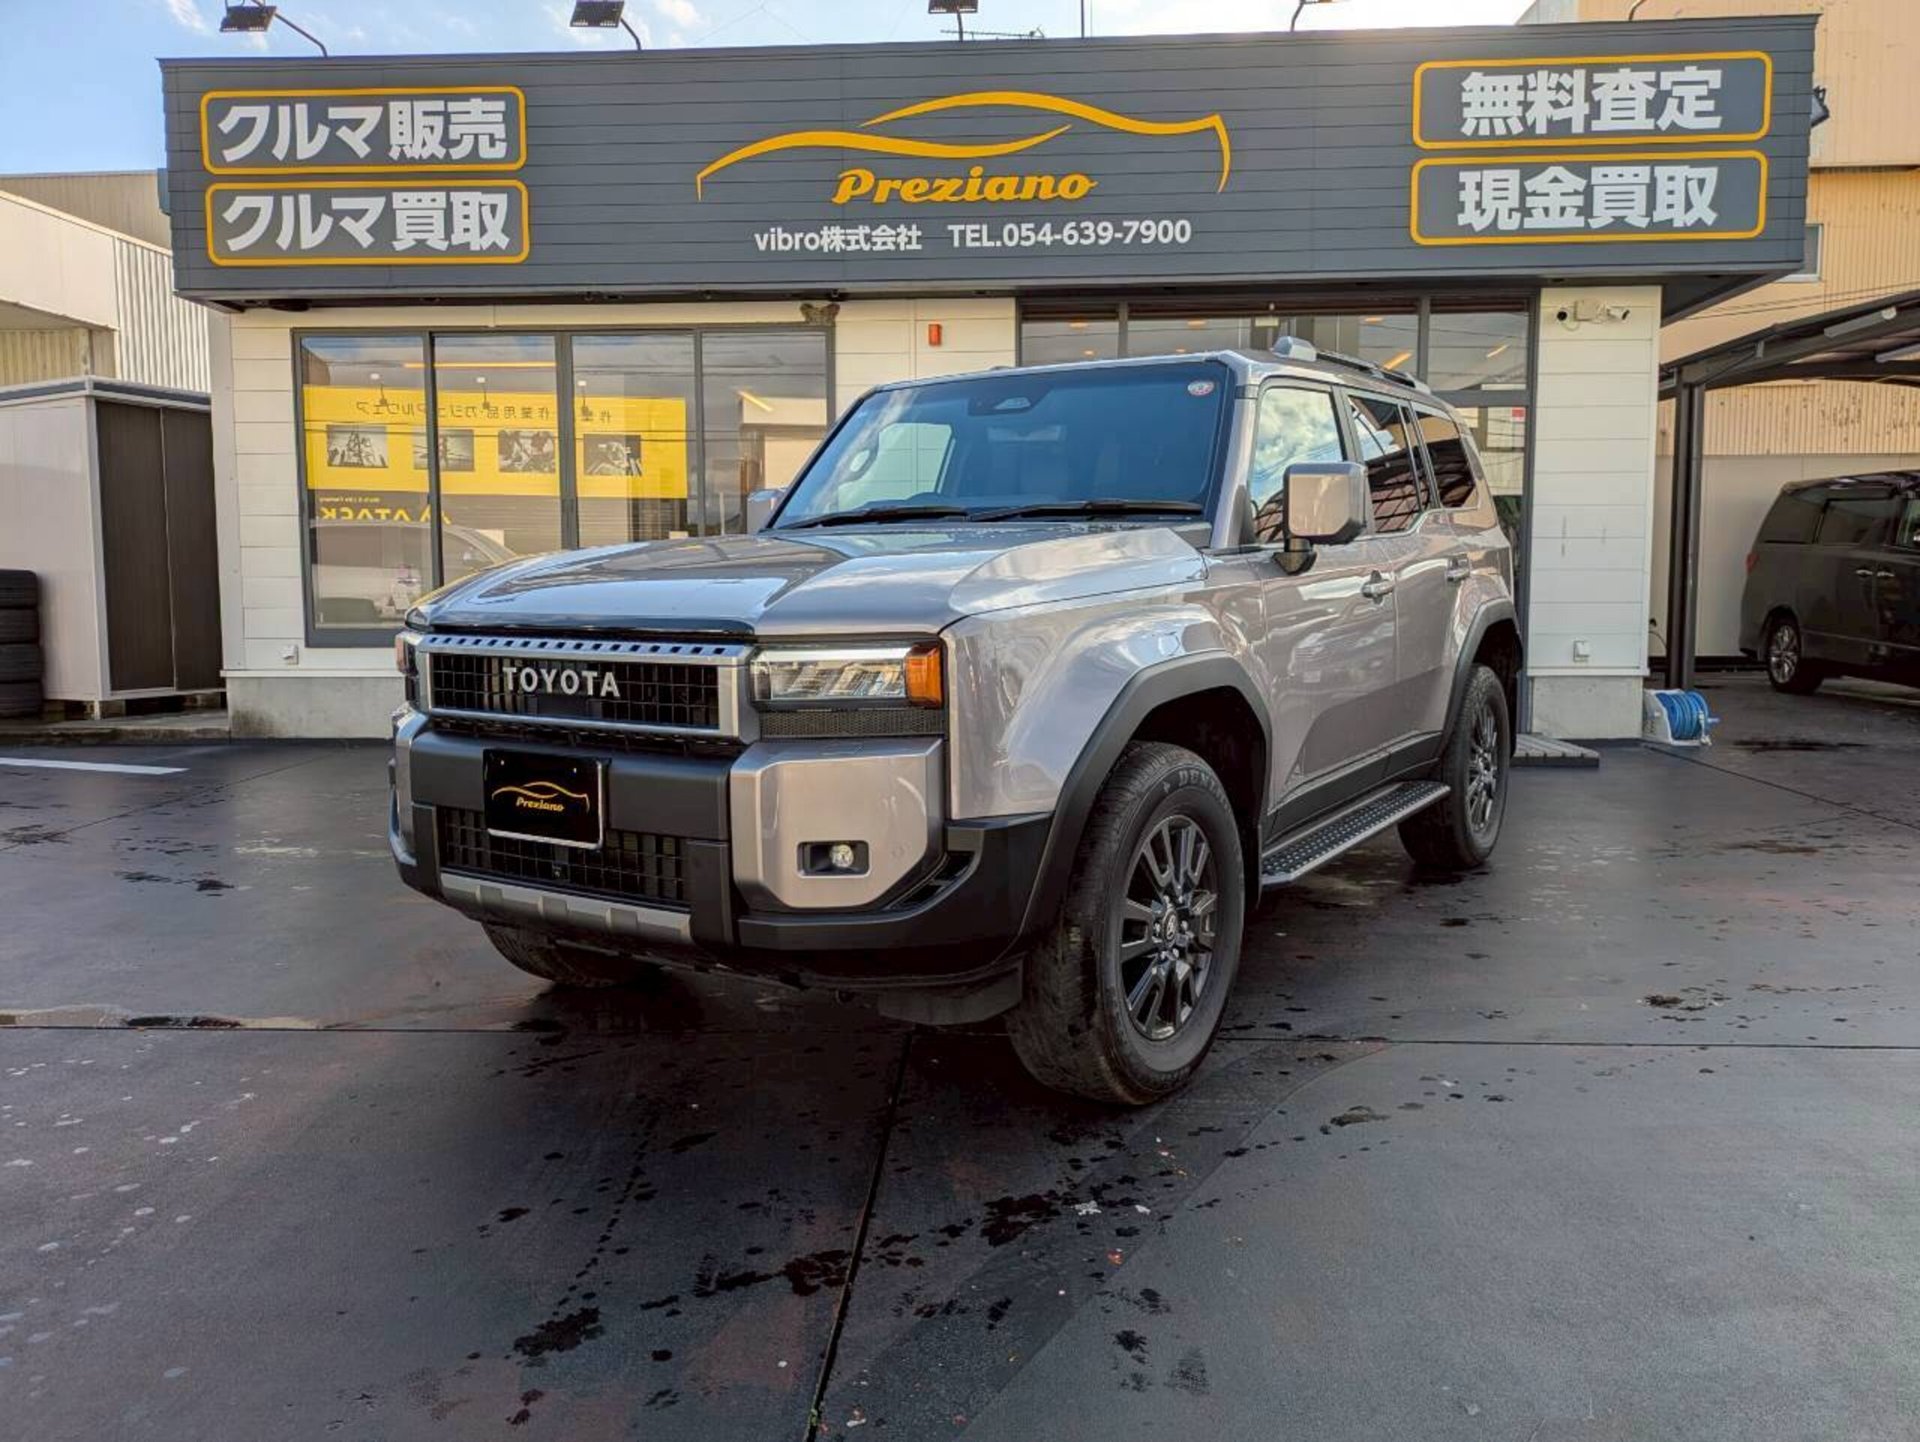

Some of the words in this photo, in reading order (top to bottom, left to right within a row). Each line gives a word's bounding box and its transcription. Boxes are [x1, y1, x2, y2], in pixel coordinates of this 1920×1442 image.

[1460, 66, 1723, 136] 無料査定
[218, 98, 508, 162] クルマ販売
[831, 166, 1098, 204] Preziano
[1457, 165, 1719, 232] 現金買取
[222, 191, 510, 251] クルマ買取
[754, 225, 922, 252] vibro株式会社
[947, 220, 1192, 248] TEL.054-639-7900
[502, 667, 620, 697] TOYOTA
[515, 796, 564, 812] Preziano
